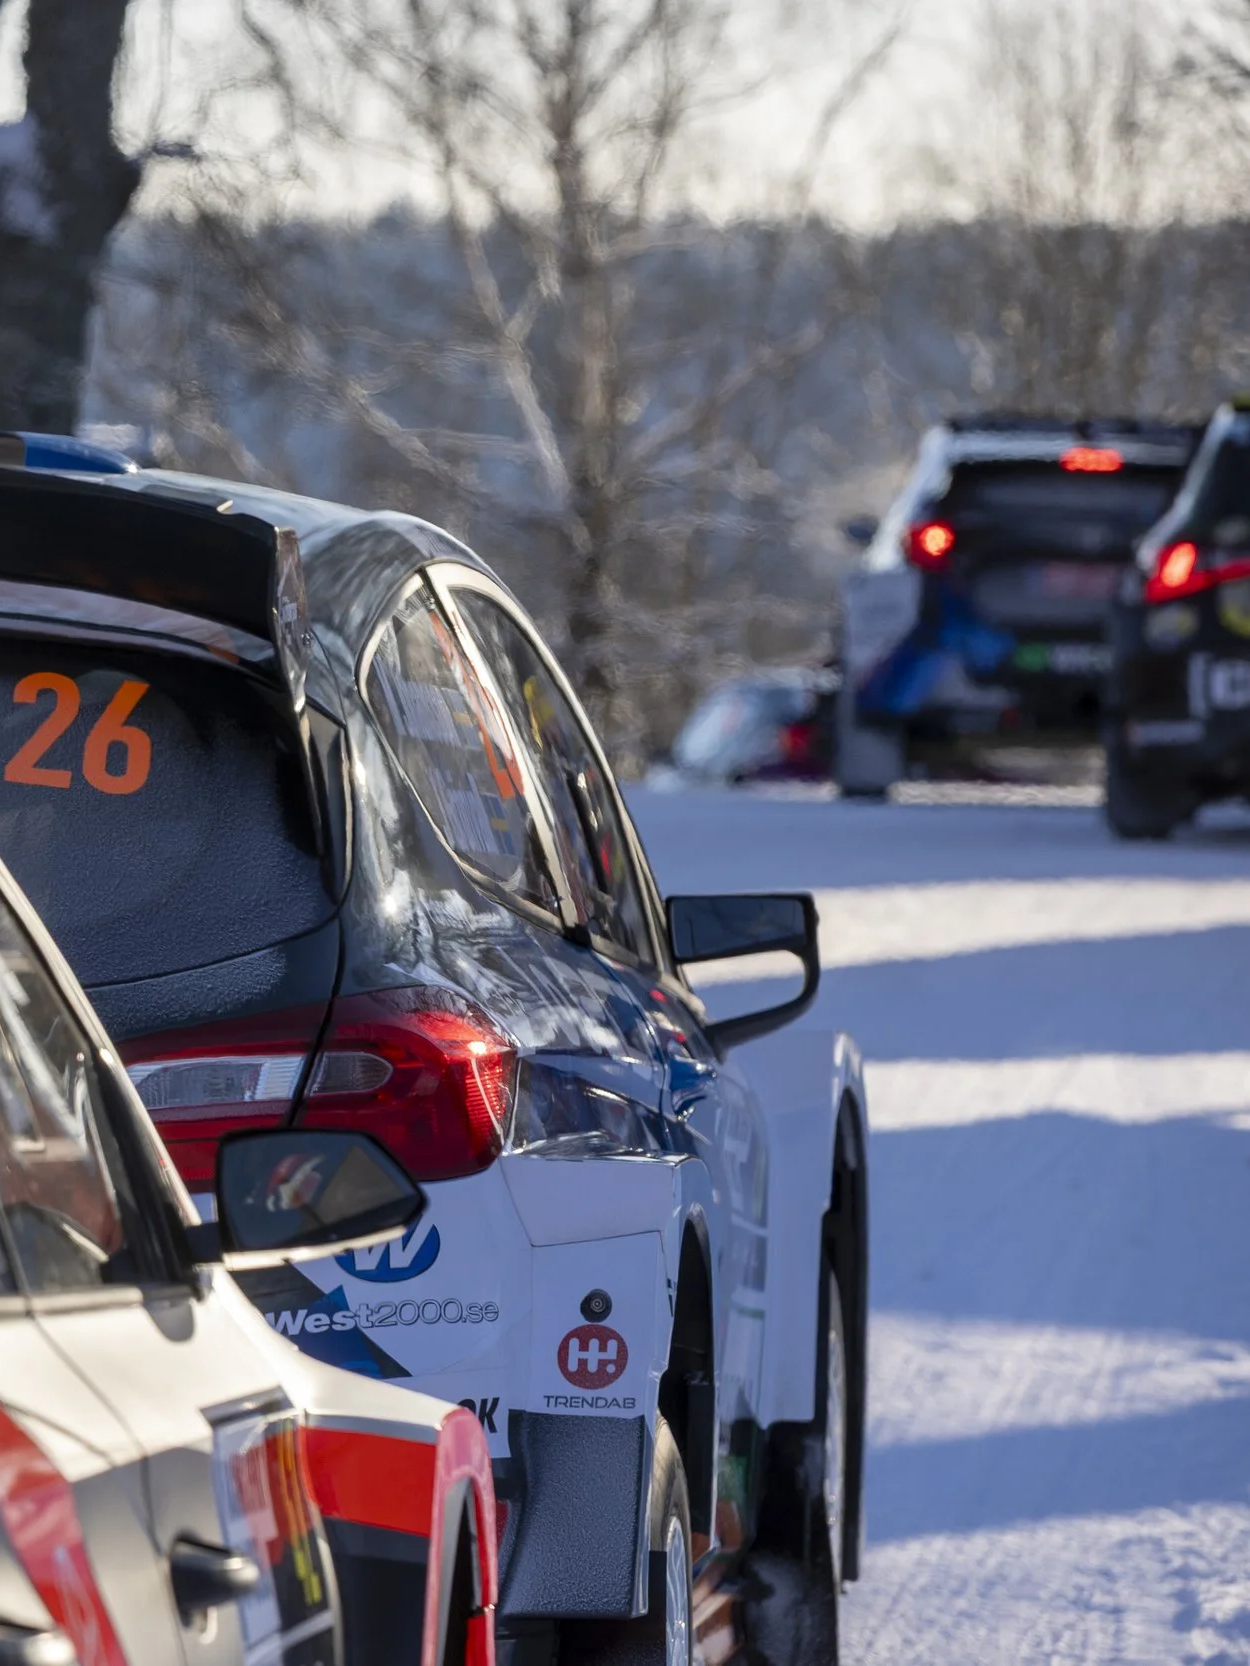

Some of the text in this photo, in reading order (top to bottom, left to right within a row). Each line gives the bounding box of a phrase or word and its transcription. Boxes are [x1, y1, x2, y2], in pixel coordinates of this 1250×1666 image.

[4, 671, 152, 794] 26
[265, 1297, 500, 1336] West2000.se
[543, 1394, 637, 1411] TRENDAB
